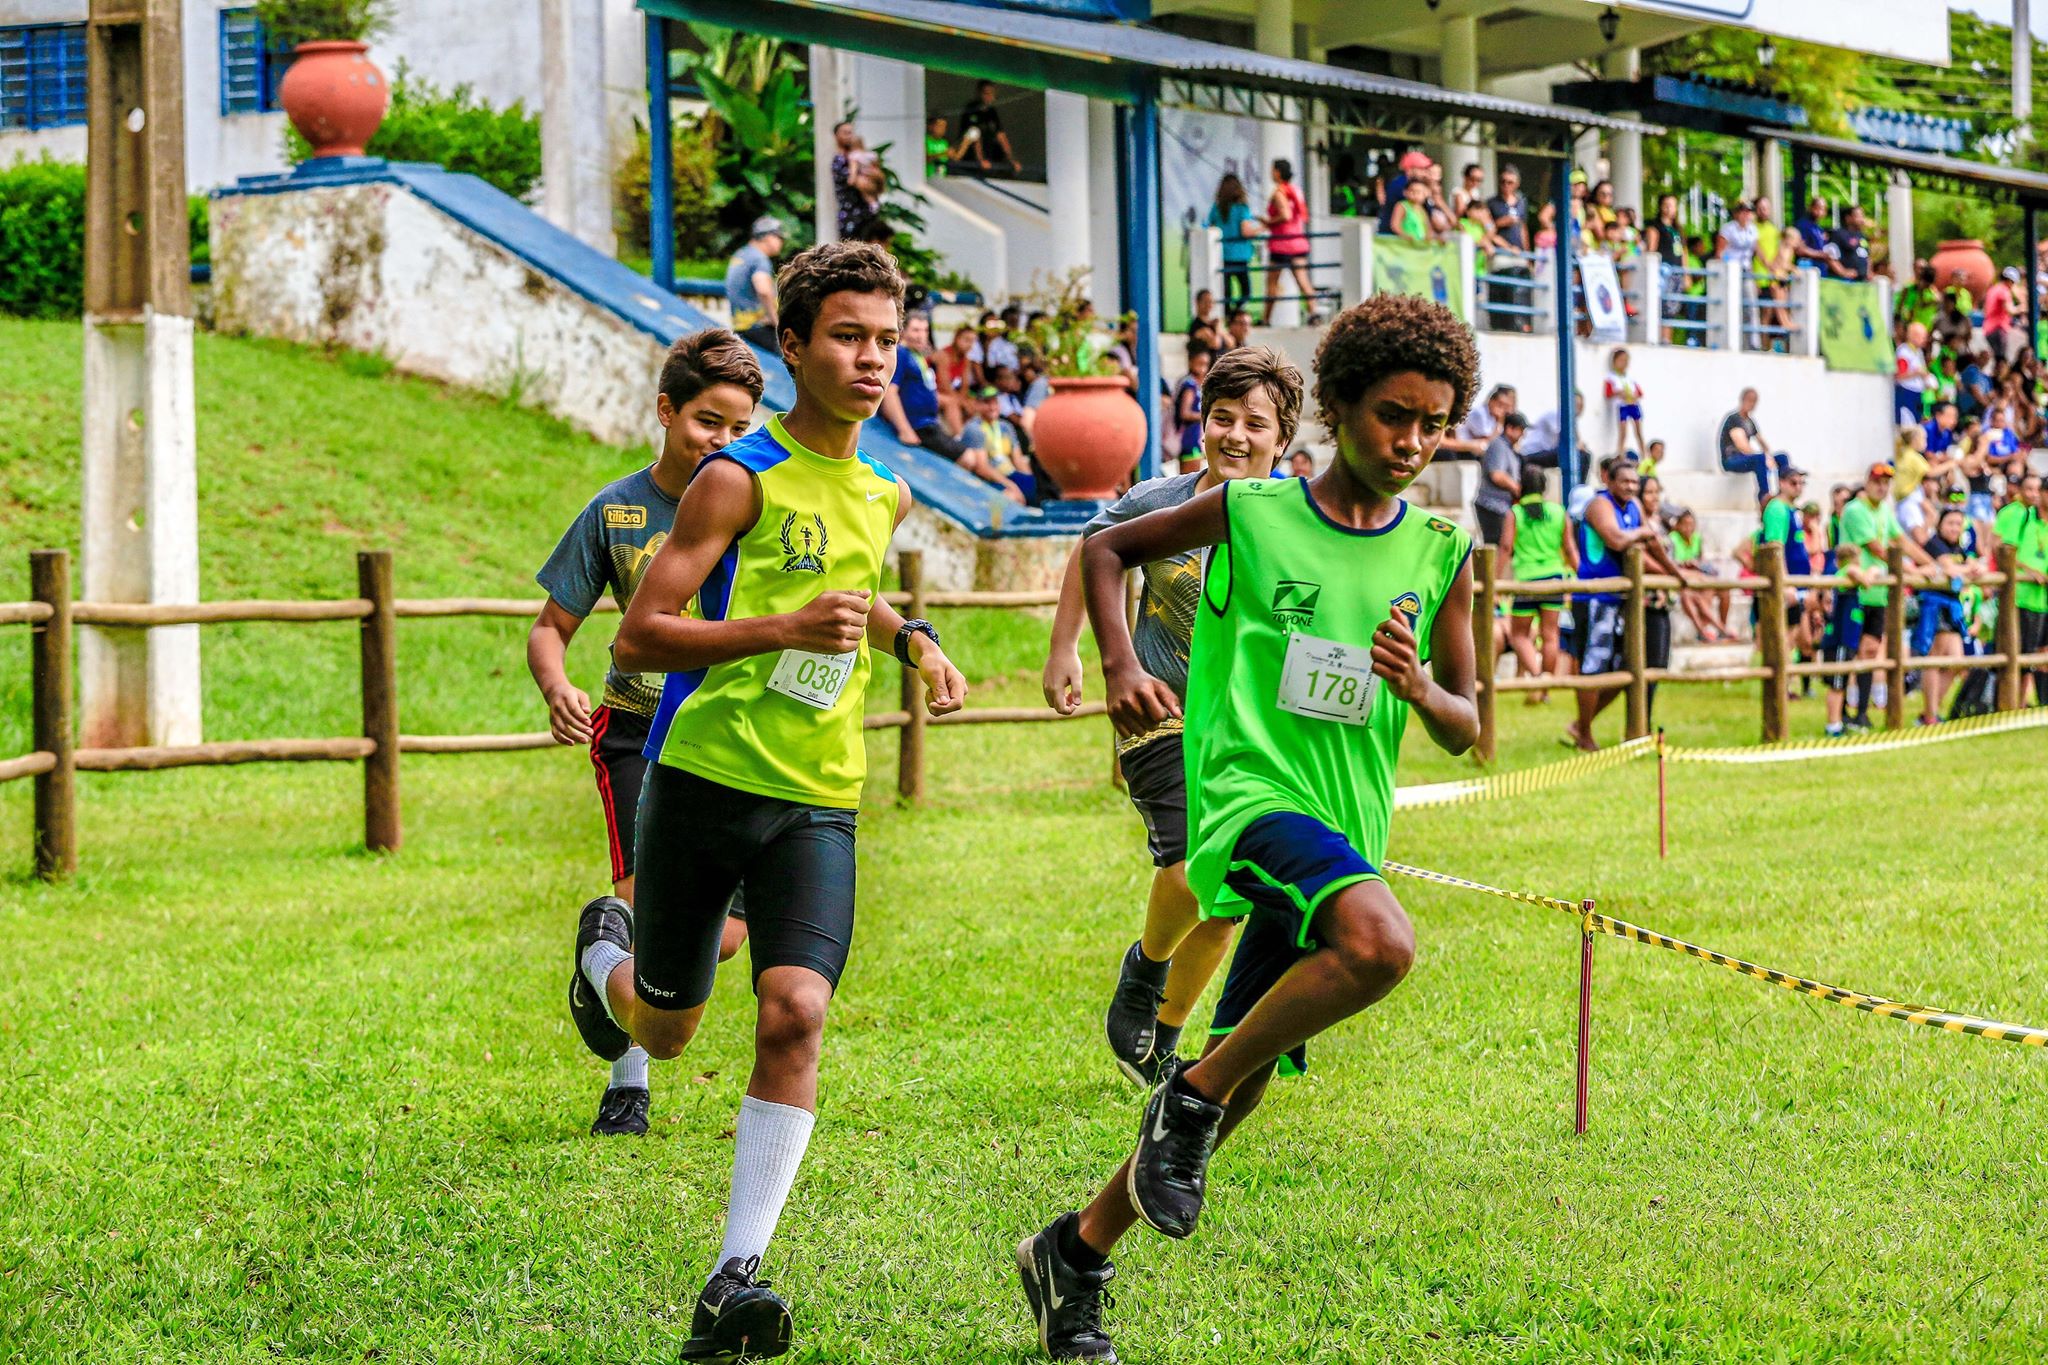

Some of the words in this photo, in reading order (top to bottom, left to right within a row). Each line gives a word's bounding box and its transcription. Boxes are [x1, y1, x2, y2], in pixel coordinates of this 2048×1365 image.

[608, 509, 641, 524] tilibra
[1271, 613, 1313, 627] ZOPONE
[797, 658, 841, 695] 038
[1307, 669, 1358, 706] 178
[638, 974, 677, 998] Topper
